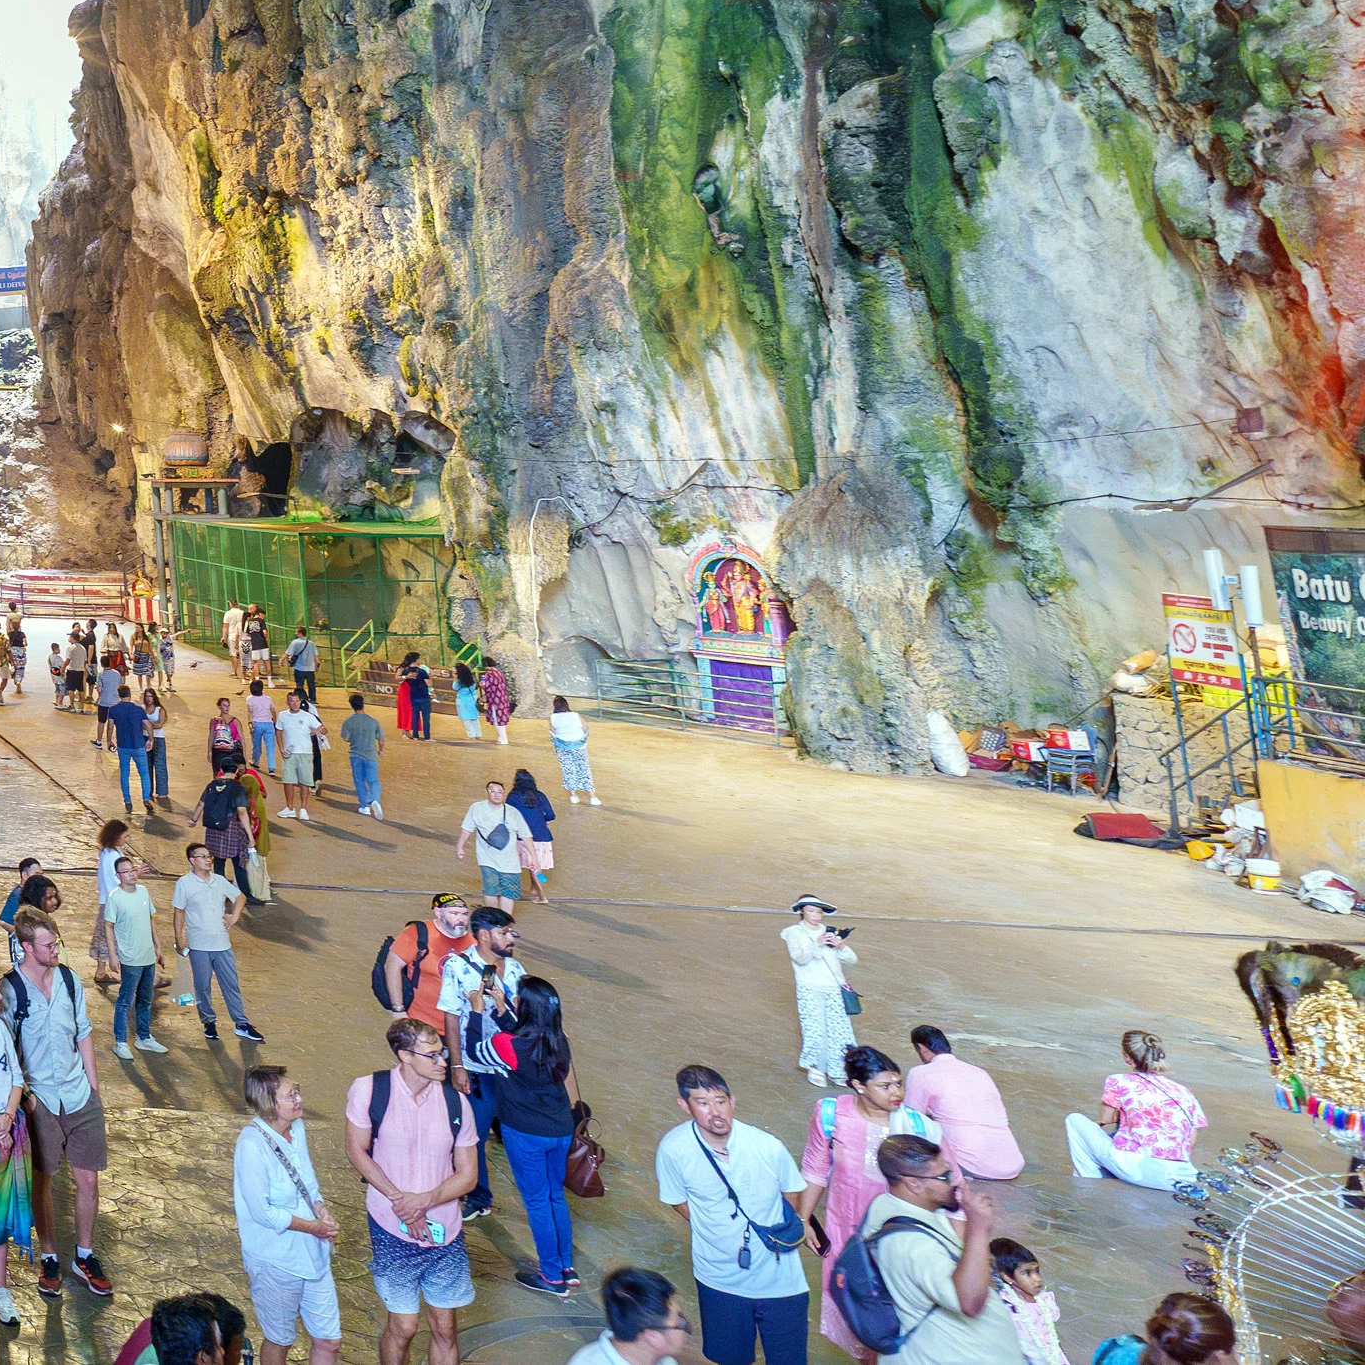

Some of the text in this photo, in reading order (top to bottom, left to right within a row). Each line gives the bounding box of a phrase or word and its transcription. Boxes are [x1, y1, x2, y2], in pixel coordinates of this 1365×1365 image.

[1292, 568, 1352, 603] Batu
[1299, 611, 1351, 639] Beauty
[375, 684, 394, 694] NO
